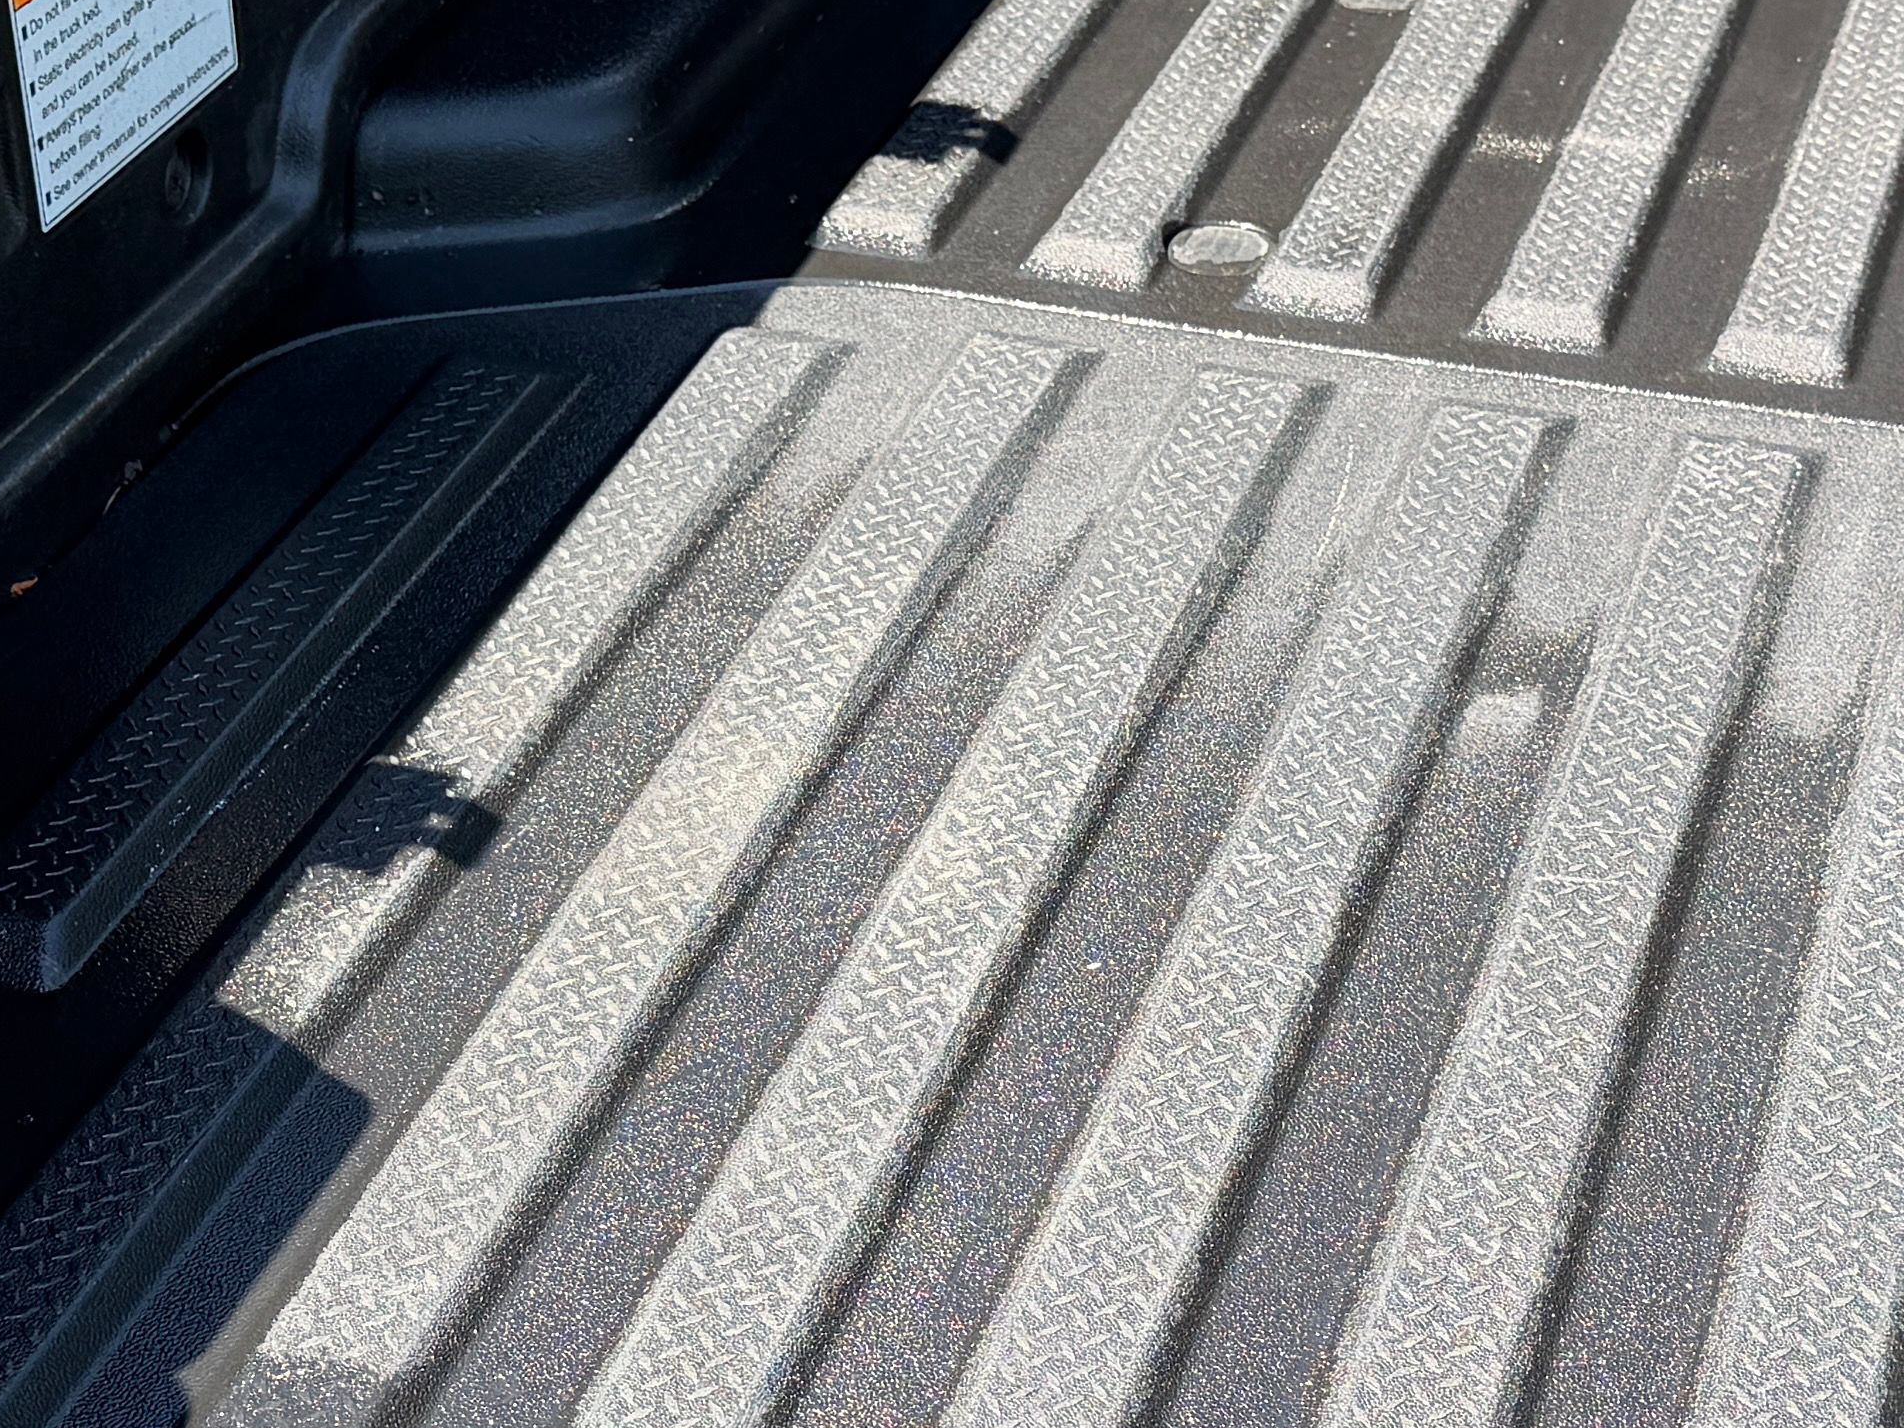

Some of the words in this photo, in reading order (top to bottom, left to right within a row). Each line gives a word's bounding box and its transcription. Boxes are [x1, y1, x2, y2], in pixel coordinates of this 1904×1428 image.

[28, 17, 44, 36] Do
[44, 1, 60, 25] not
[32, 49, 43, 65] in
[43, 36, 59, 56] the
[59, 17, 83, 44] truck
[37, 63, 64, 91] Static
[64, 32, 104, 71] electricity
[105, 18, 122, 38] can
[122, 0, 145, 27] ignite
[41, 94, 59, 120] and
[59, 83, 77, 109] you
[78, 69, 95, 91] can
[94, 59, 107, 77] be
[44, 109, 78, 148] Always
[77, 94, 101, 125] place
[141, 51, 153, 69] on
[153, 40, 167, 59] the
[48, 144, 77, 175] before
[53, 179, 71, 201] See
[105, 120, 137, 156] manual
[136, 112, 149, 128] for
[150, 82, 186, 120] complete
